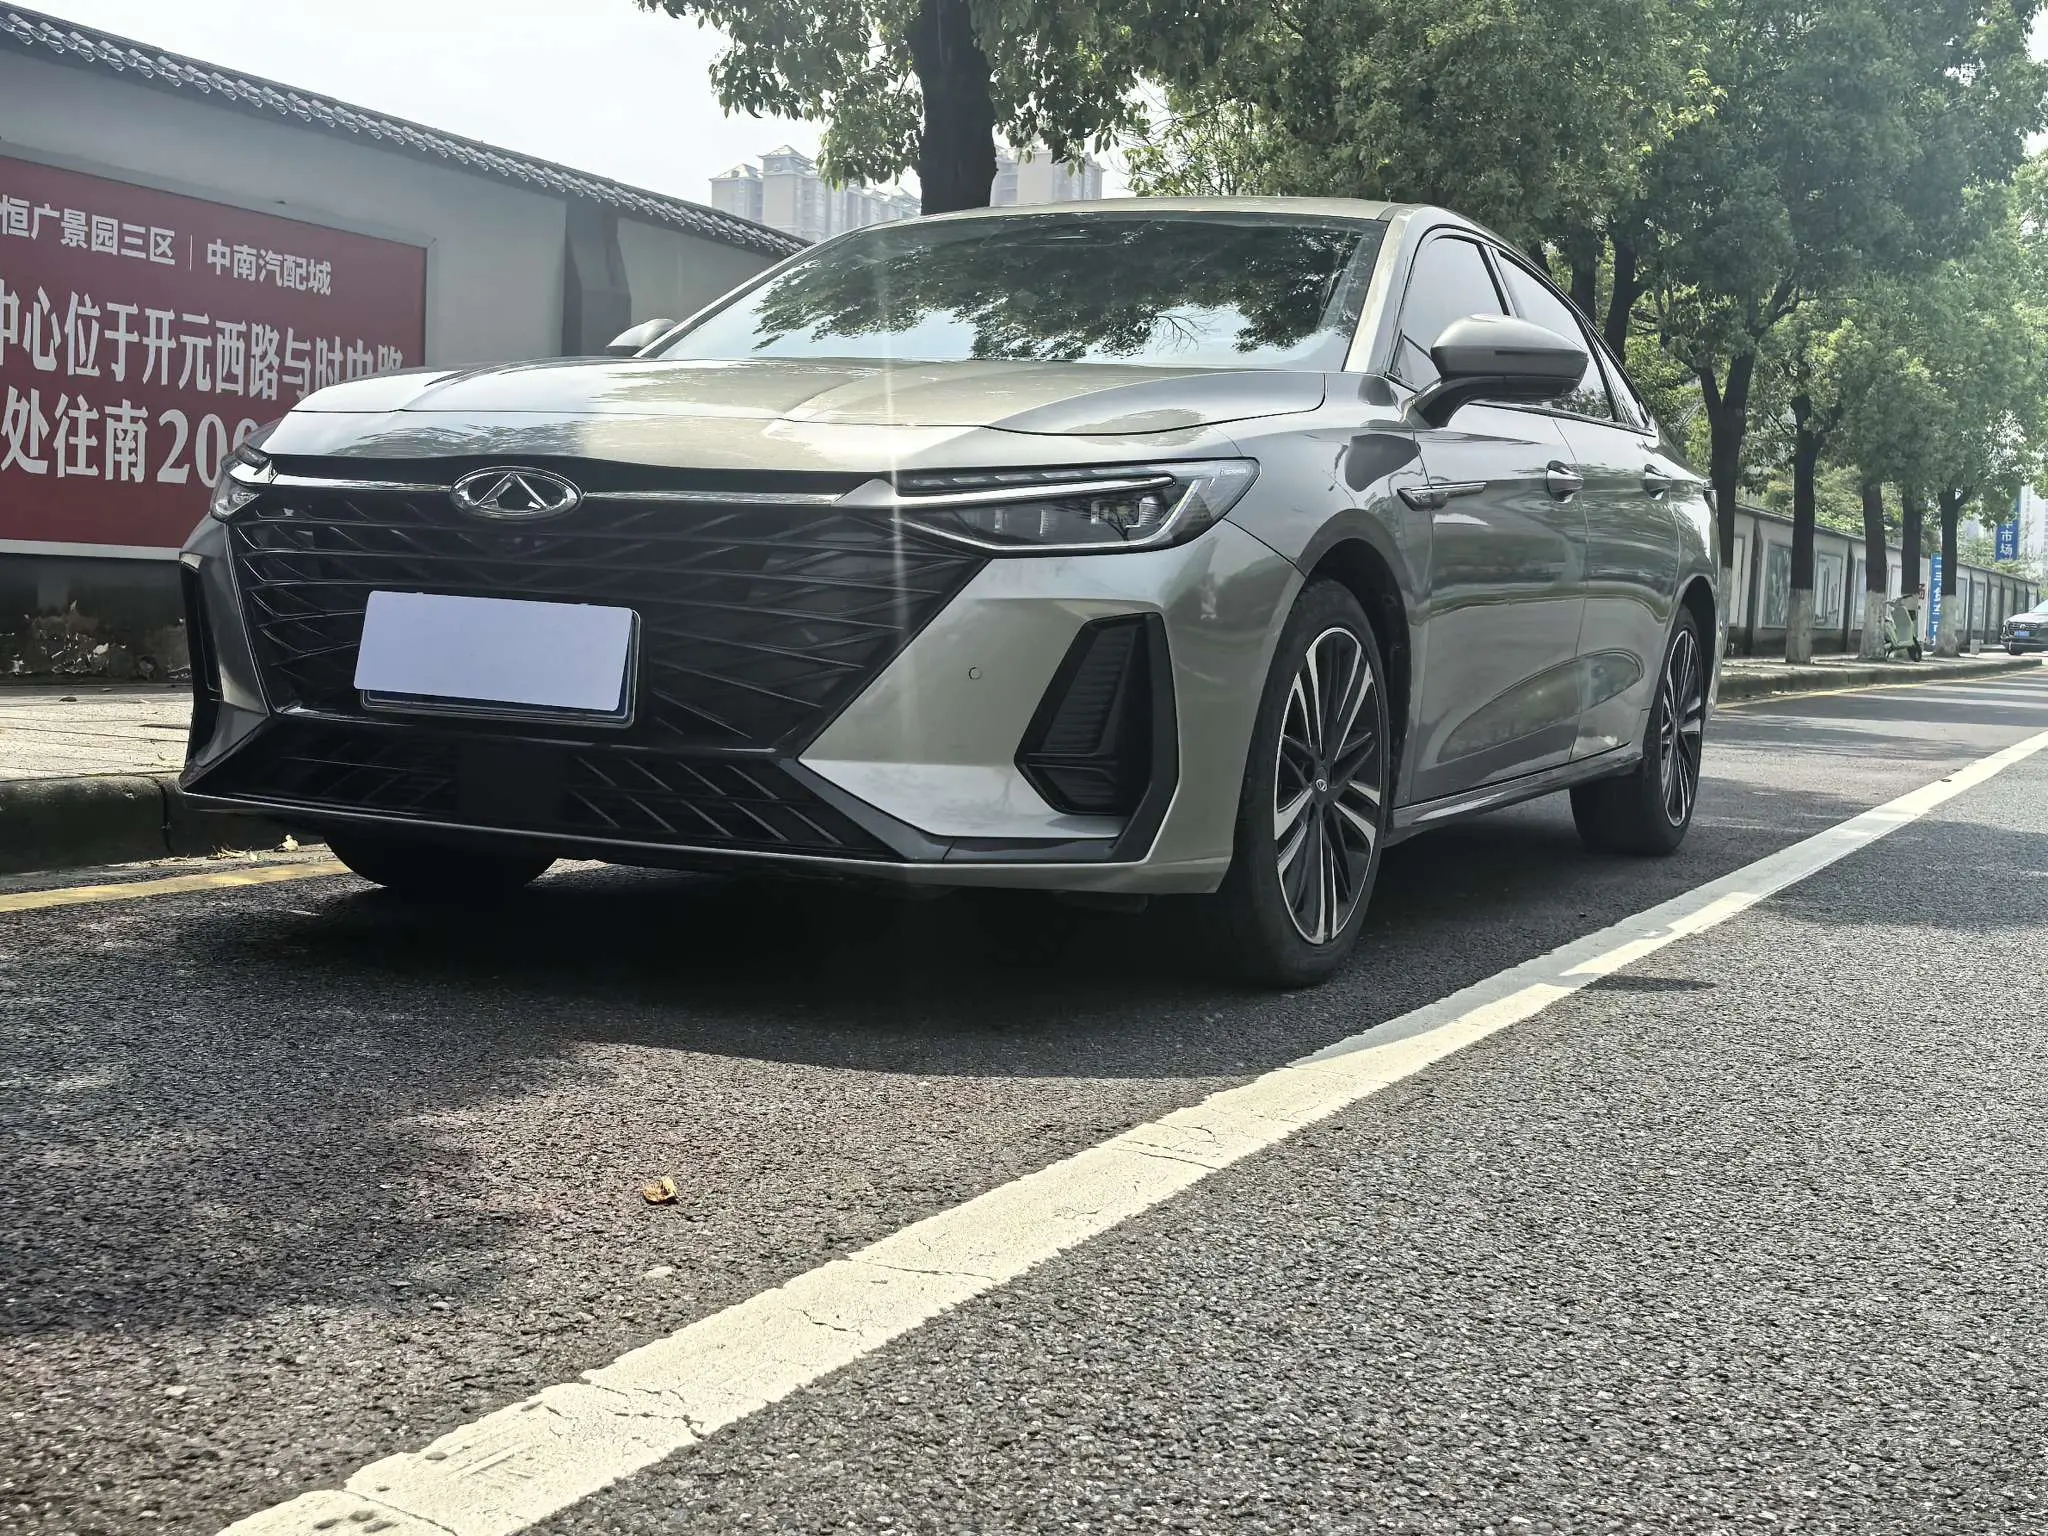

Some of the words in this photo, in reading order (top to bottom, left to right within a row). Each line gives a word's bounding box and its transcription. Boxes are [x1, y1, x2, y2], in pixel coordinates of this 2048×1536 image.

[0, 194, 176, 265] 恒广景园三区
[207, 239, 332, 295] 中南汽配城
